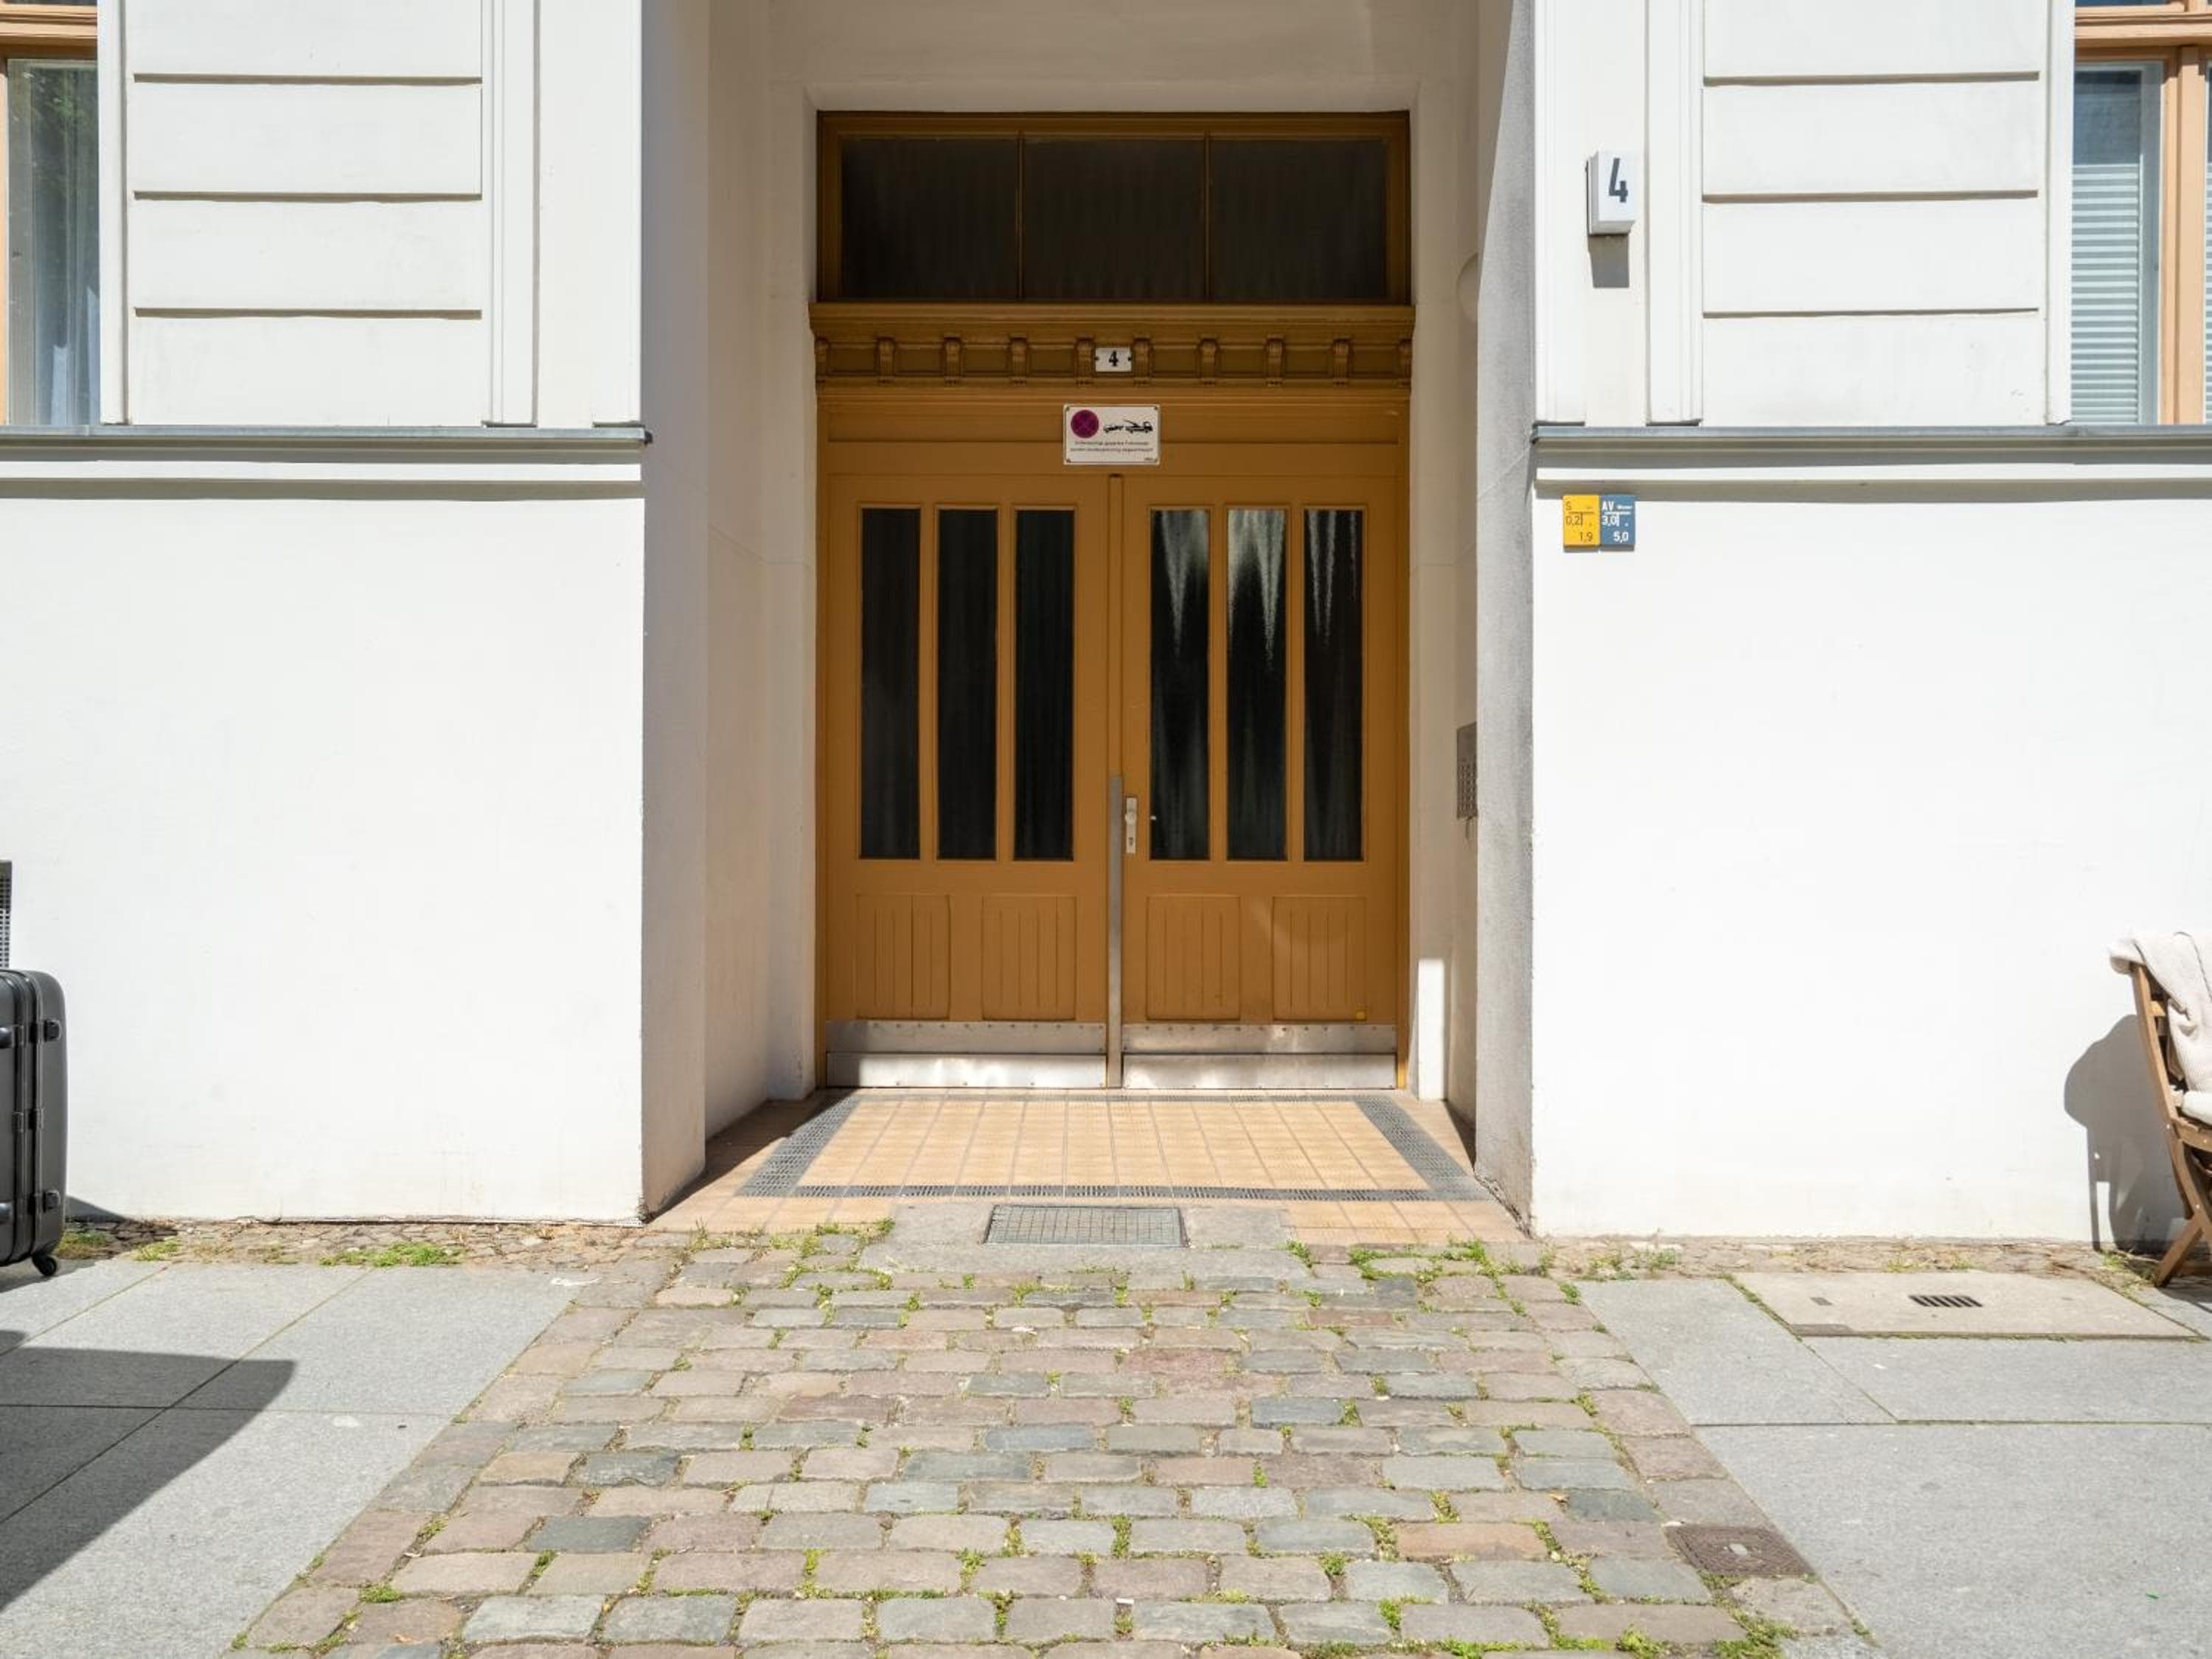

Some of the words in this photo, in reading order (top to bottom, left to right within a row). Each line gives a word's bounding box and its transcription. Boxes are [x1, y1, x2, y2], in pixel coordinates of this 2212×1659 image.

[1609, 158, 1628, 203] 4
[1109, 350, 1119, 366] 4
[1601, 501, 1613, 511] AV
[1601, 515, 1616, 526] 3,0
[1613, 531, 1629, 543] 5,0
